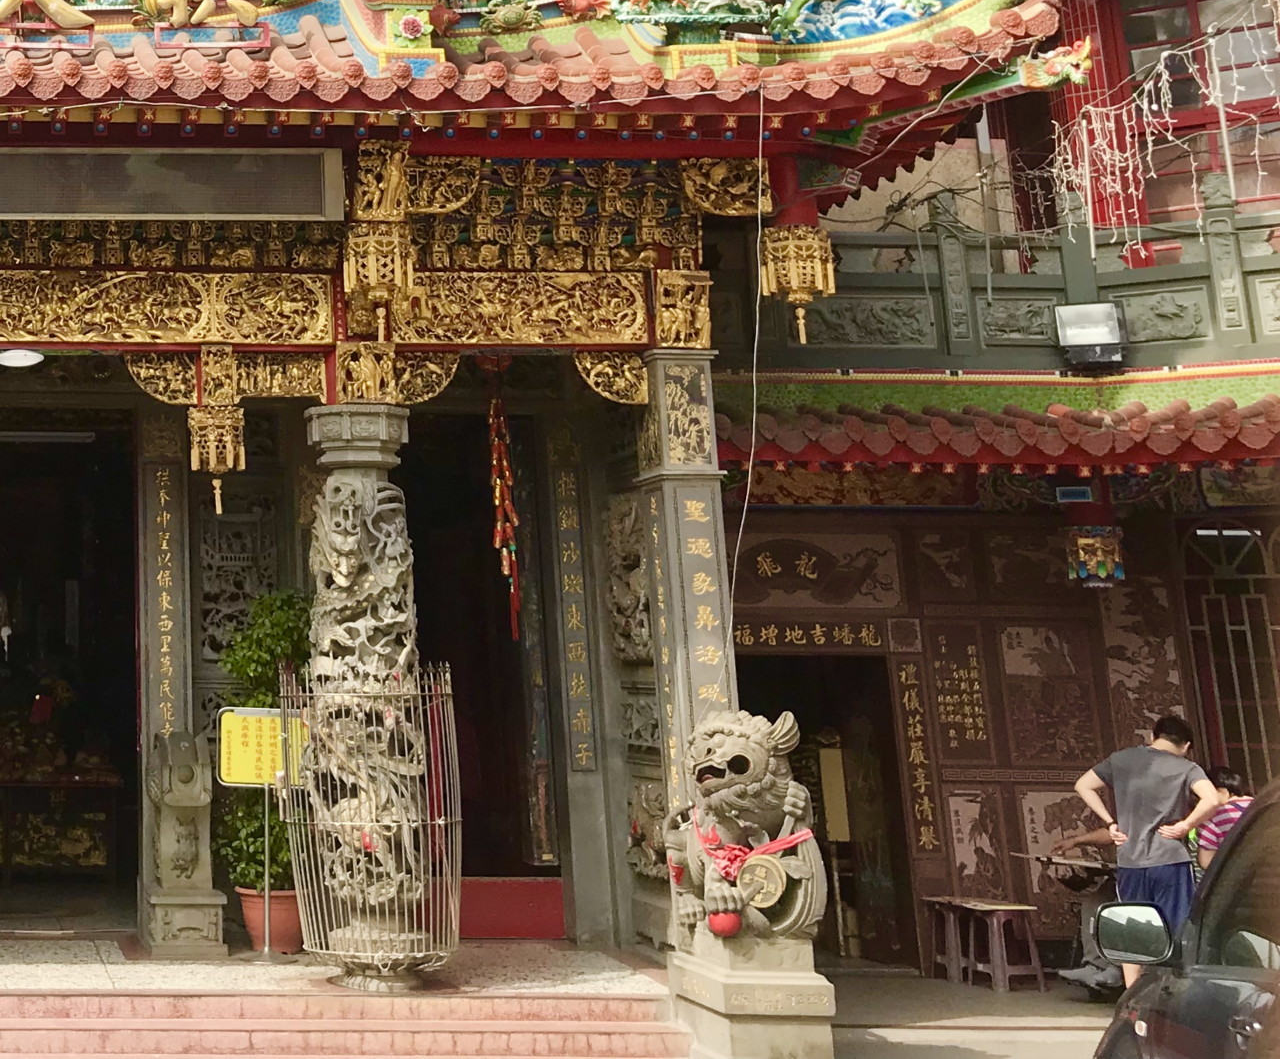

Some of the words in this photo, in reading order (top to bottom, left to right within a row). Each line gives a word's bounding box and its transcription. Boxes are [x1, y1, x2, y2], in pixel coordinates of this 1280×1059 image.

[756, 551, 819, 579] 龍飛
[734, 623, 883, 648] 龍蟠吉地增福
